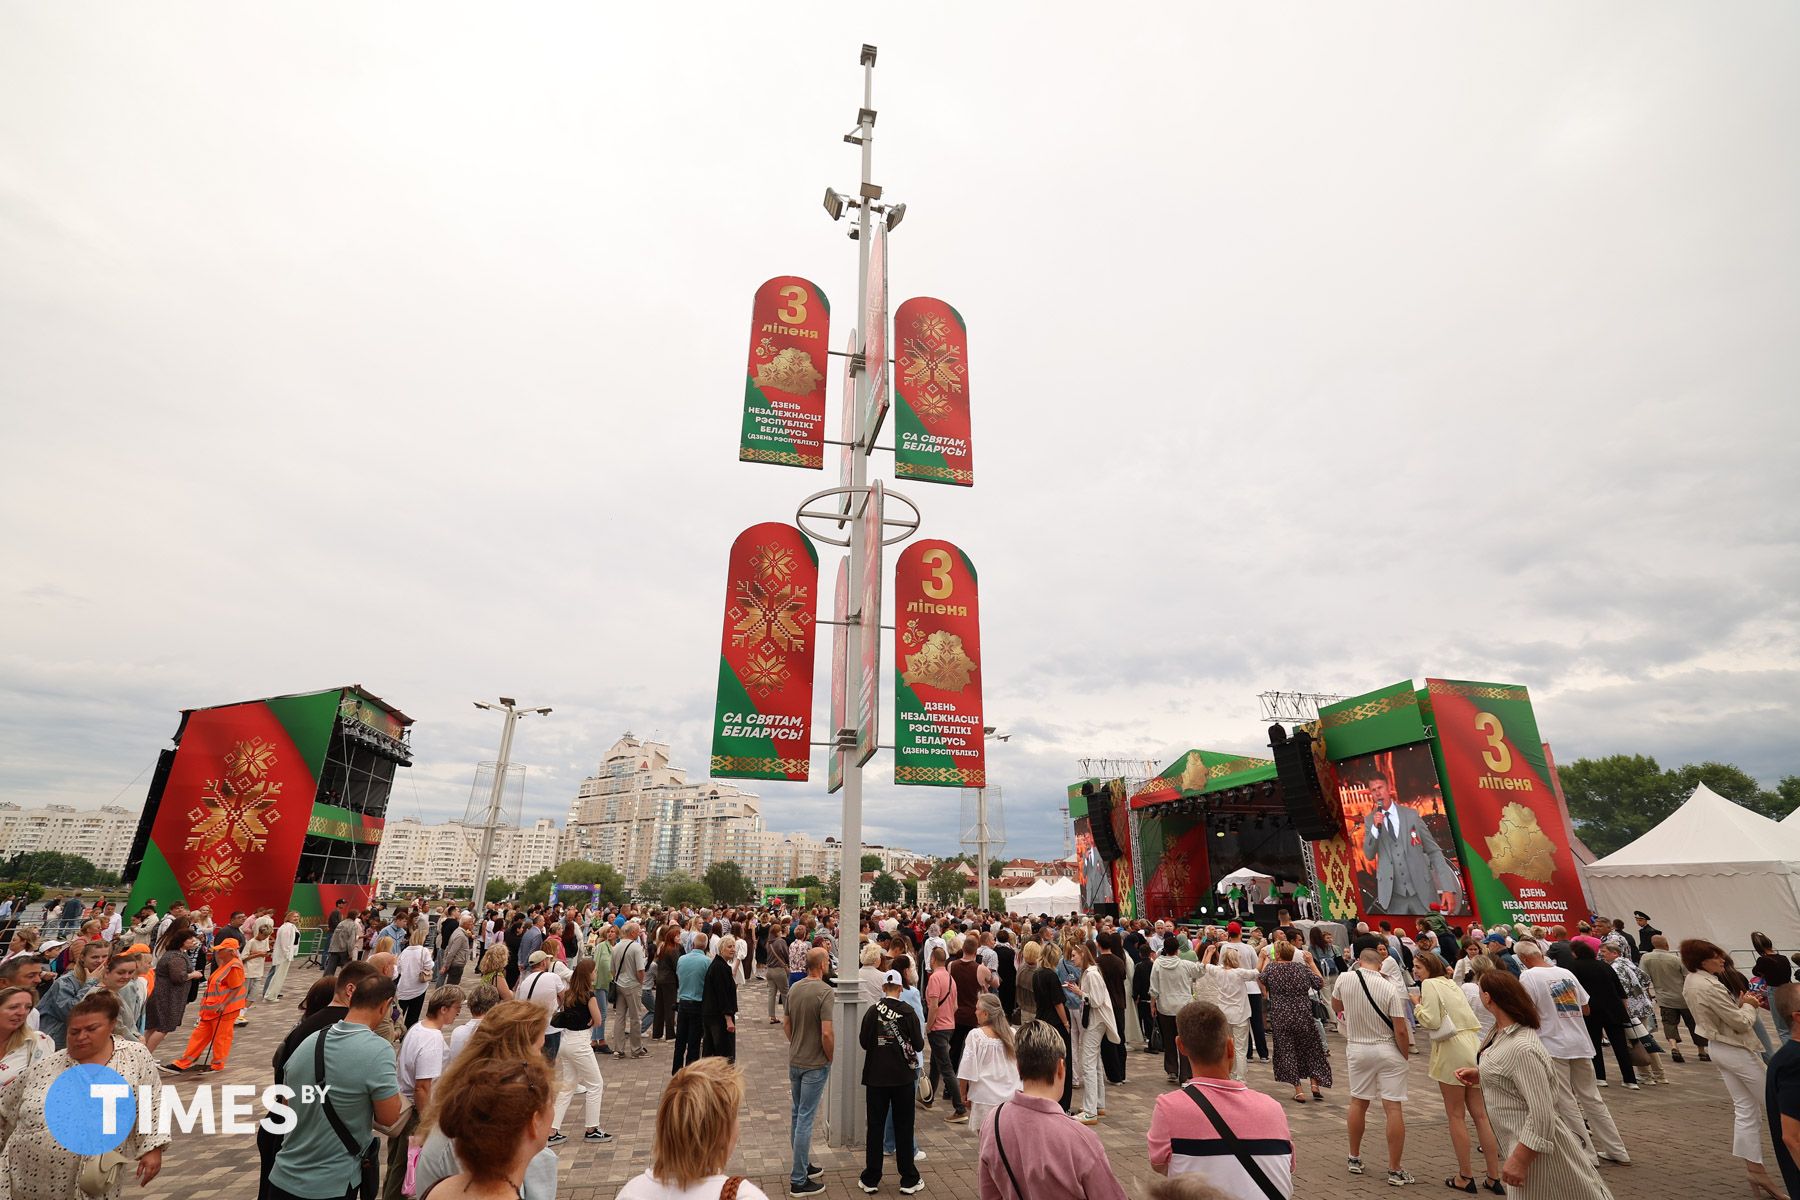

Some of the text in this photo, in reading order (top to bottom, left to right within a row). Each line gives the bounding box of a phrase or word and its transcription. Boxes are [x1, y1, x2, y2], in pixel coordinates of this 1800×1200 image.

[778, 285, 808, 324] 3
[762, 323, 819, 339] ліпеня
[770, 401, 801, 410] ДЗЕНЬ
[748, 406, 822, 421] НЕЗАЛЕЖНАСЦІ
[755, 416, 814, 429] РЭСПУБЛІКІ
[747, 433, 773, 441] (ДЗЕНЬ
[760, 426, 808, 437] БЕЛАРУСЬ
[902, 432, 967, 448] СА СВЯТАМ,
[902, 441, 967, 457] БЕЛАРУСЬ!
[922, 548, 953, 600] 3
[906, 599, 968, 617] ліпеня
[924, 702, 956, 712] ДЗЕНЬ
[722, 712, 804, 728] СА СВЯТАМ,
[900, 711, 980, 725] НЕЗАЛЕЖНАСЦІ
[721, 725, 804, 740] БЕЛАРУСЬ!
[909, 724, 972, 735] РЭСПУБЛІКІ
[915, 735, 967, 746] БЕЛАРУСЬ
[1474, 712, 1512, 773] 3
[902, 746, 979, 758] (ДЗЕНЬ РЭСПУБЛІКІ)
[1478, 772, 1533, 791] ліпеня
[1519, 888, 1547, 898] ДЗЕНЬ
[1502, 900, 1568, 911] НЕЗАЛЕЖНАСЦІ
[1512, 913, 1565, 923] РЭСПУБЛІКІ
